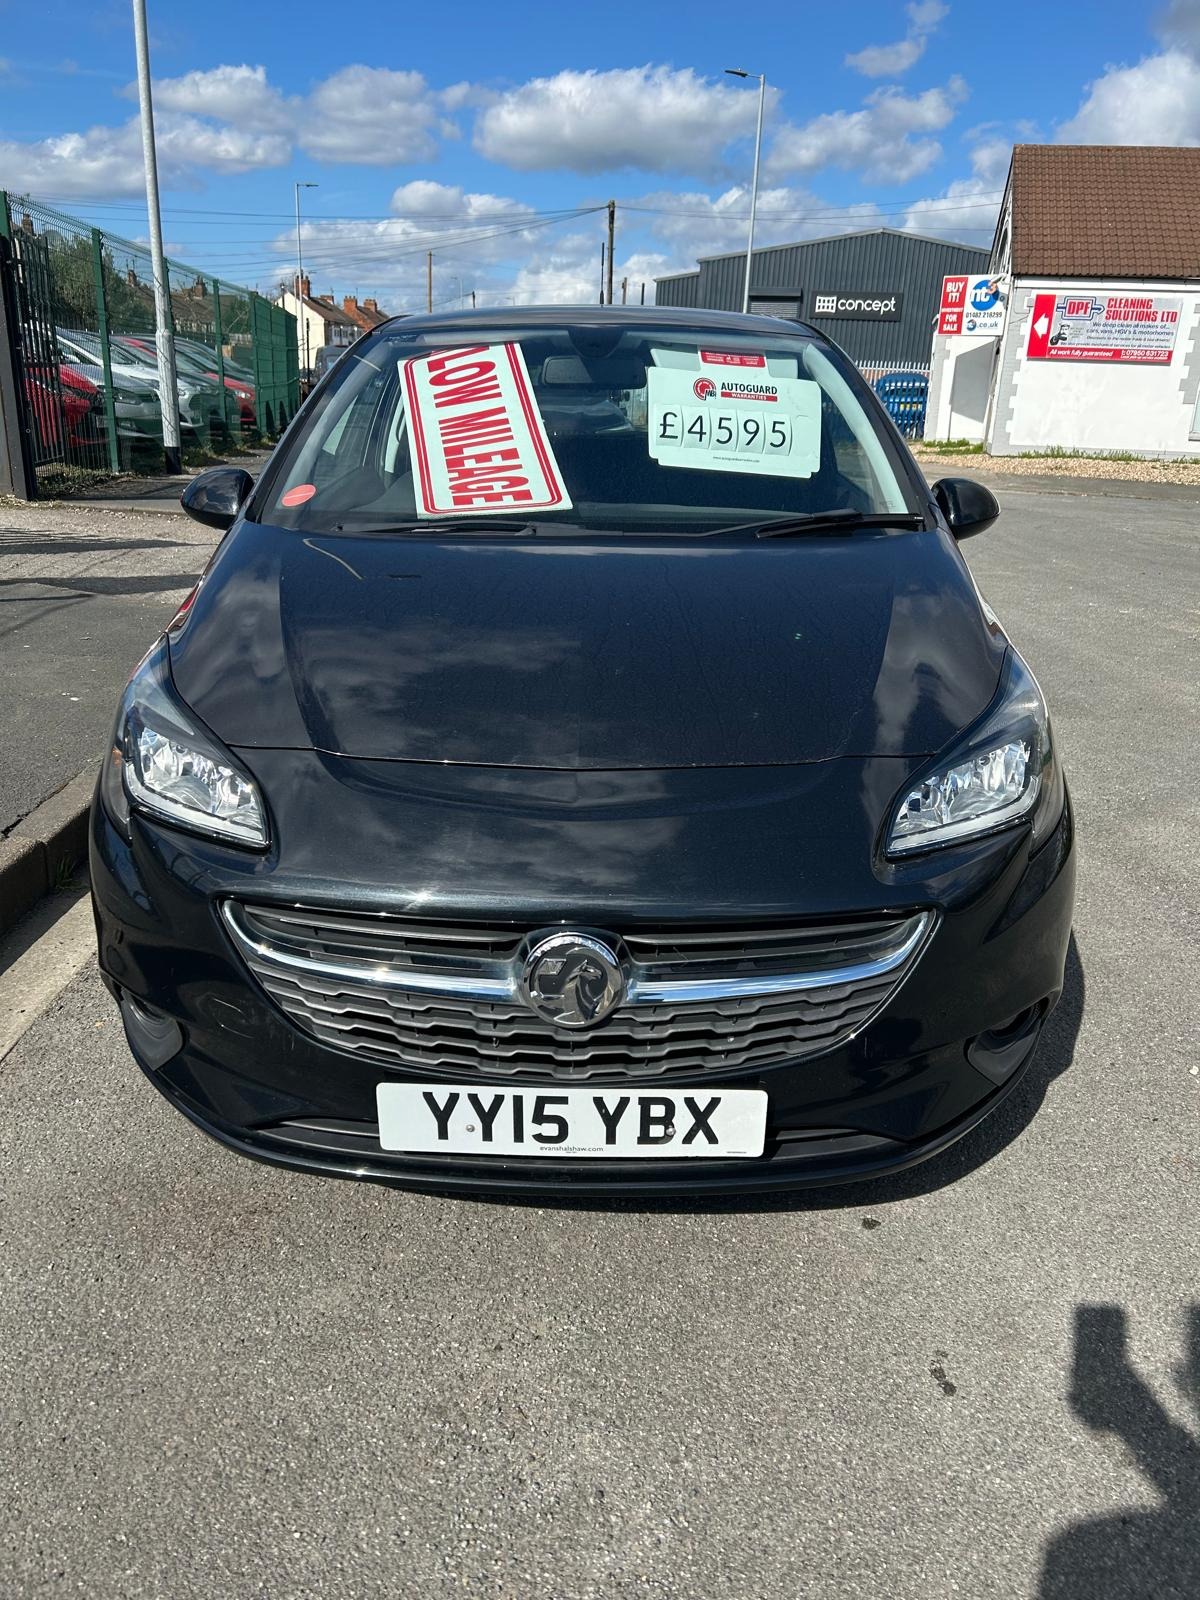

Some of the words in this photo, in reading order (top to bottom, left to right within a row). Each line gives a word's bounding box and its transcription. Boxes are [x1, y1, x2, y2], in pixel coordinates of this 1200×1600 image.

[946, 282, 965, 293] BUY
[948, 292, 960, 303] IT!
[1107, 298, 1153, 309] CLEANING
[838, 297, 896, 315] concept
[1067, 301, 1091, 315] DPF
[946, 314, 957, 322] FOR
[1105, 310, 1158, 322] SOLUTIONS
[1161, 311, 1178, 323] LTD
[1071, 349, 1083, 357] fully
[427, 345, 502, 408] LOW
[721, 382, 778, 395] AUTOGUARD
[659, 412, 786, 448] £4595
[439, 406, 533, 506] MILEAGE
[422, 1092, 569, 1144] YY15
[592, 1096, 722, 1145] YBX
